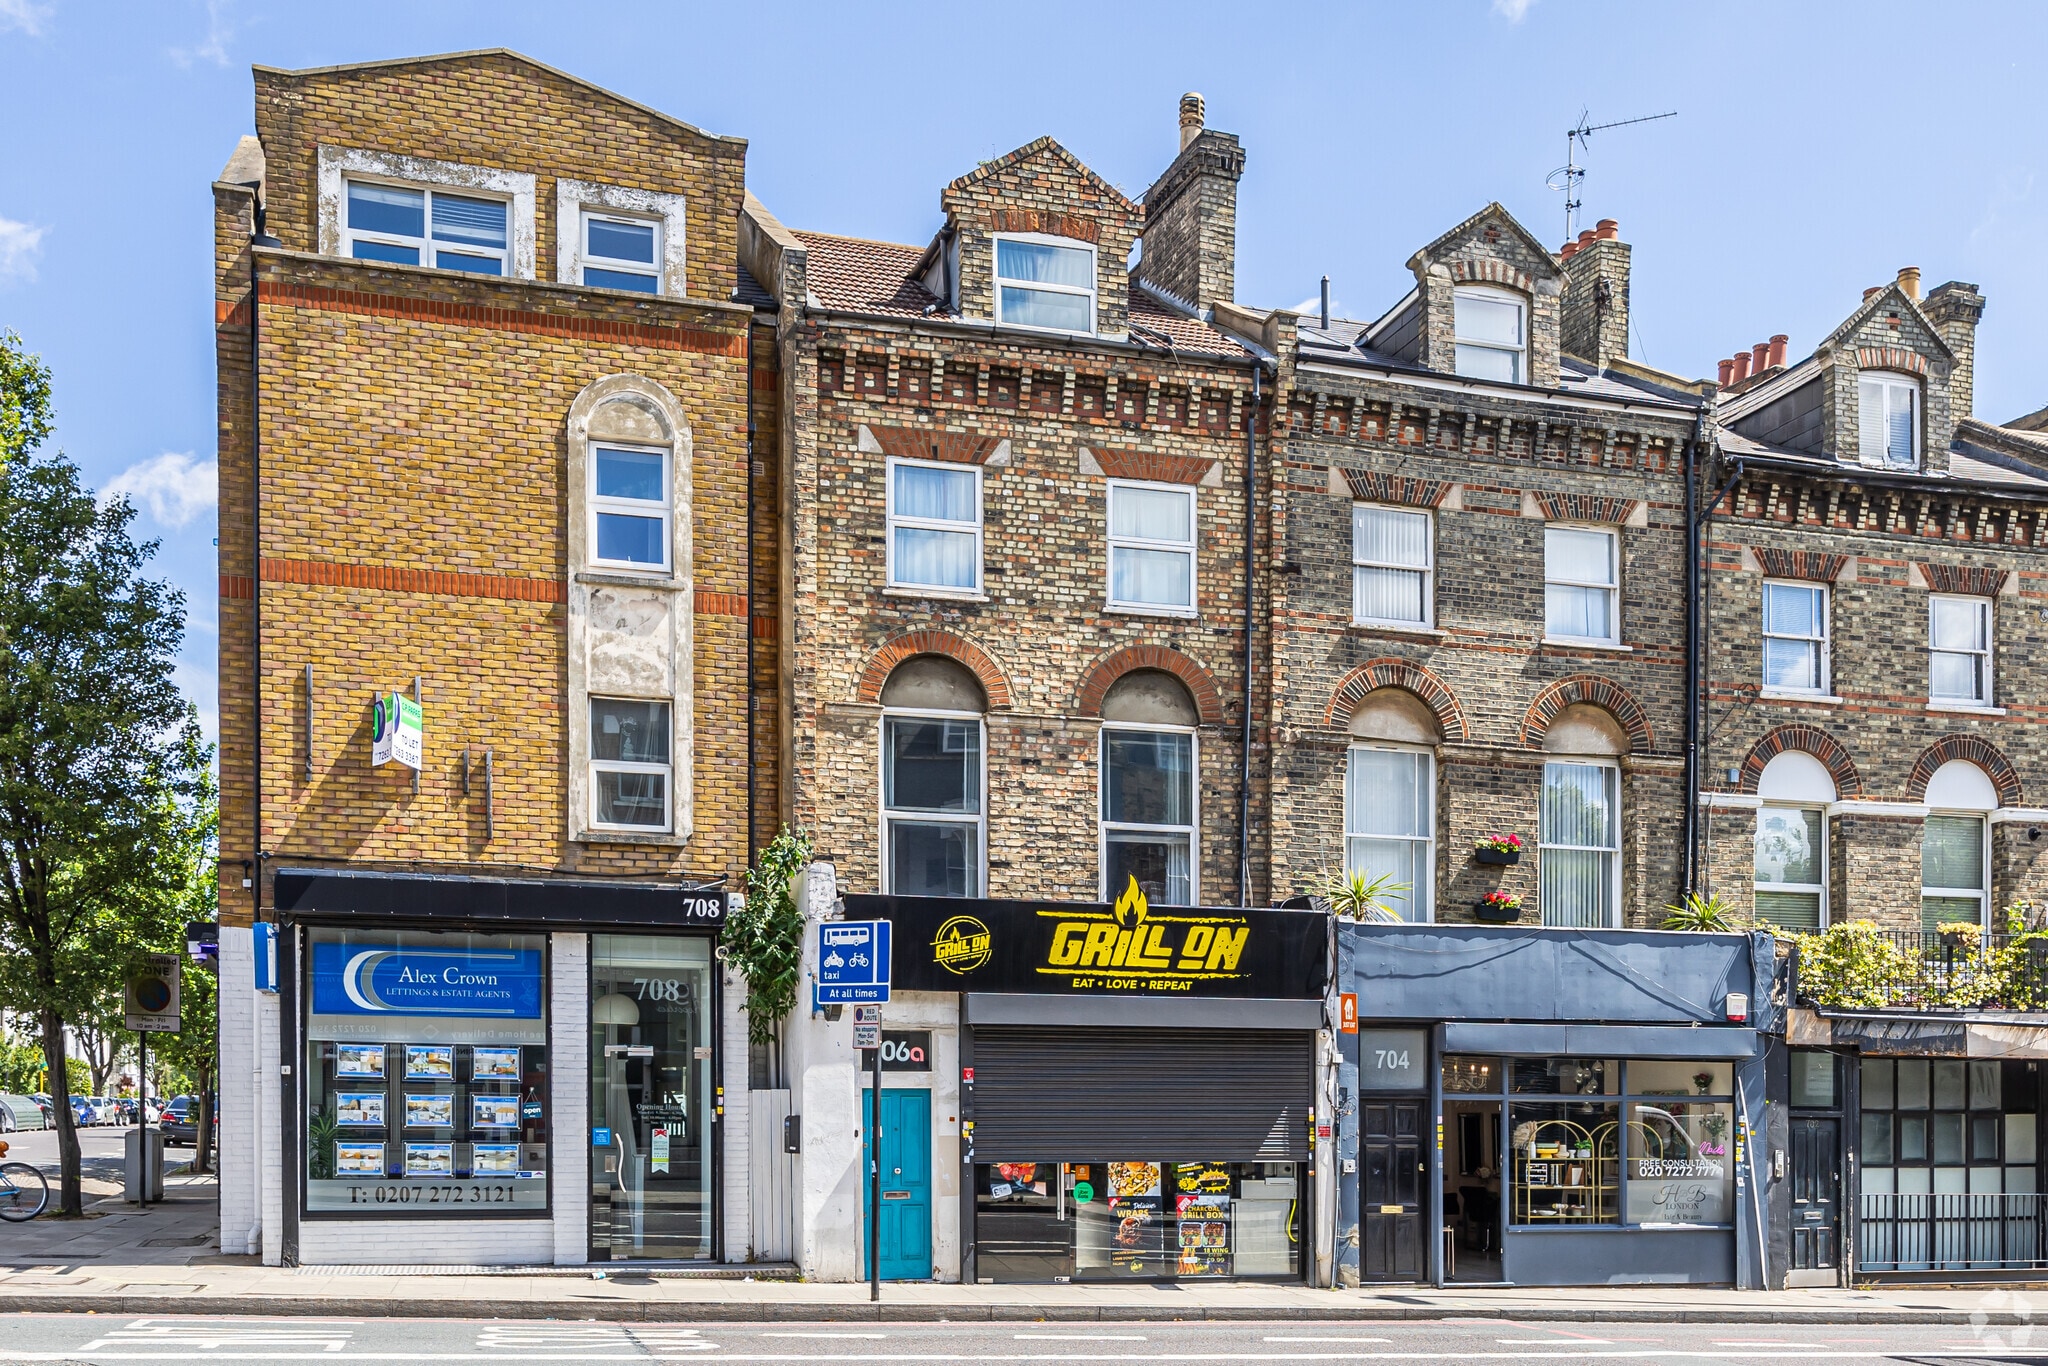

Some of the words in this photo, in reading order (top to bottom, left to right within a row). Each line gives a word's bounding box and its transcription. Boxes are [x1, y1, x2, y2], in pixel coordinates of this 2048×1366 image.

[682, 898, 720, 918] 708
[936, 940, 970, 959] GRILL
[971, 934, 991, 952] ON
[1048, 922, 1173, 968] GRILL
[1177, 926, 1250, 970] ON
[142, 966, 170, 976] ONE
[398, 966, 437, 985] Alex
[443, 966, 498, 986] Crown
[824, 971, 840, 980] taxi
[1072, 978, 1095, 988] EAT
[1105, 979, 1137, 989] LOVE
[1148, 980, 1193, 990] REPEAT
[386, 988, 431, 997] LETTINGS
[432, 989, 439, 997] &
[441, 989, 473, 998] ESTATE
[475, 990, 511, 998] AGENTS
[633, 978, 680, 1002] 708
[829, 989, 839, 998] At
[841, 989, 852, 998] all
[855, 989, 878, 998] times
[881, 1040, 924, 1062] 06a
[1375, 1050, 1410, 1070] 704
[523, 1107, 541, 1117] open
[636, 1103, 664, 1111] Opening
[1639, 1159, 1660, 1167] FREE
[1661, 1159, 1724, 1167] CONSULTATION
[1639, 1166, 1663, 1177] 020
[1665, 1166, 1693, 1177] 7272
[347, 1186, 368, 1204] T:
[375, 1186, 423, 1204] 0207
[429, 1186, 463, 1203] 272
[470, 1186, 515, 1203] 3121
[1665, 1202, 1700, 1210] LONDON
[1181, 1211, 1205, 1219] GRILL
[1206, 1211, 1224, 1219] BOX
[77, 1318, 365, 1352] LANE
